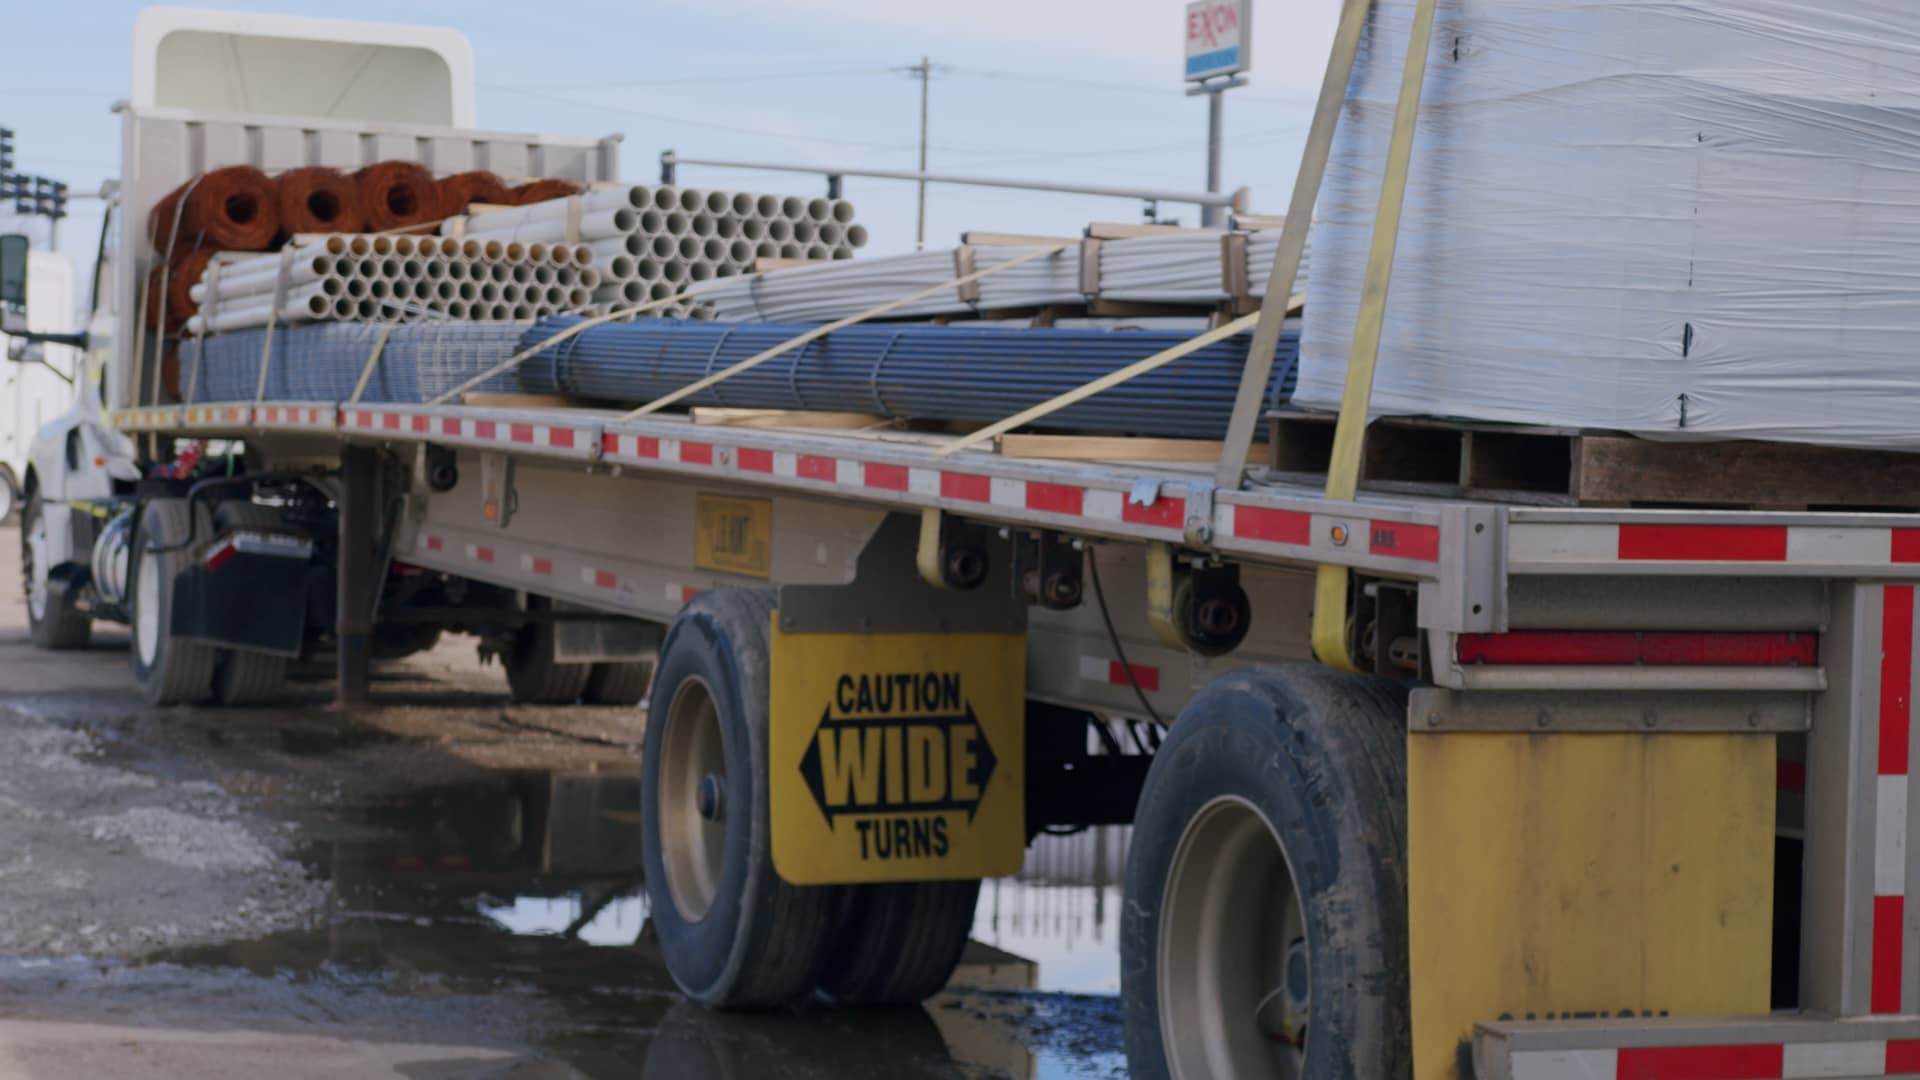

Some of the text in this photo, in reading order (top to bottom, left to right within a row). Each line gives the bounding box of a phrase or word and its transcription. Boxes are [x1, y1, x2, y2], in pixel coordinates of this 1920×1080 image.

[837, 672, 960, 714] CAUTION
[817, 723, 980, 807] WIDE
[855, 816, 949, 860] TURNS
